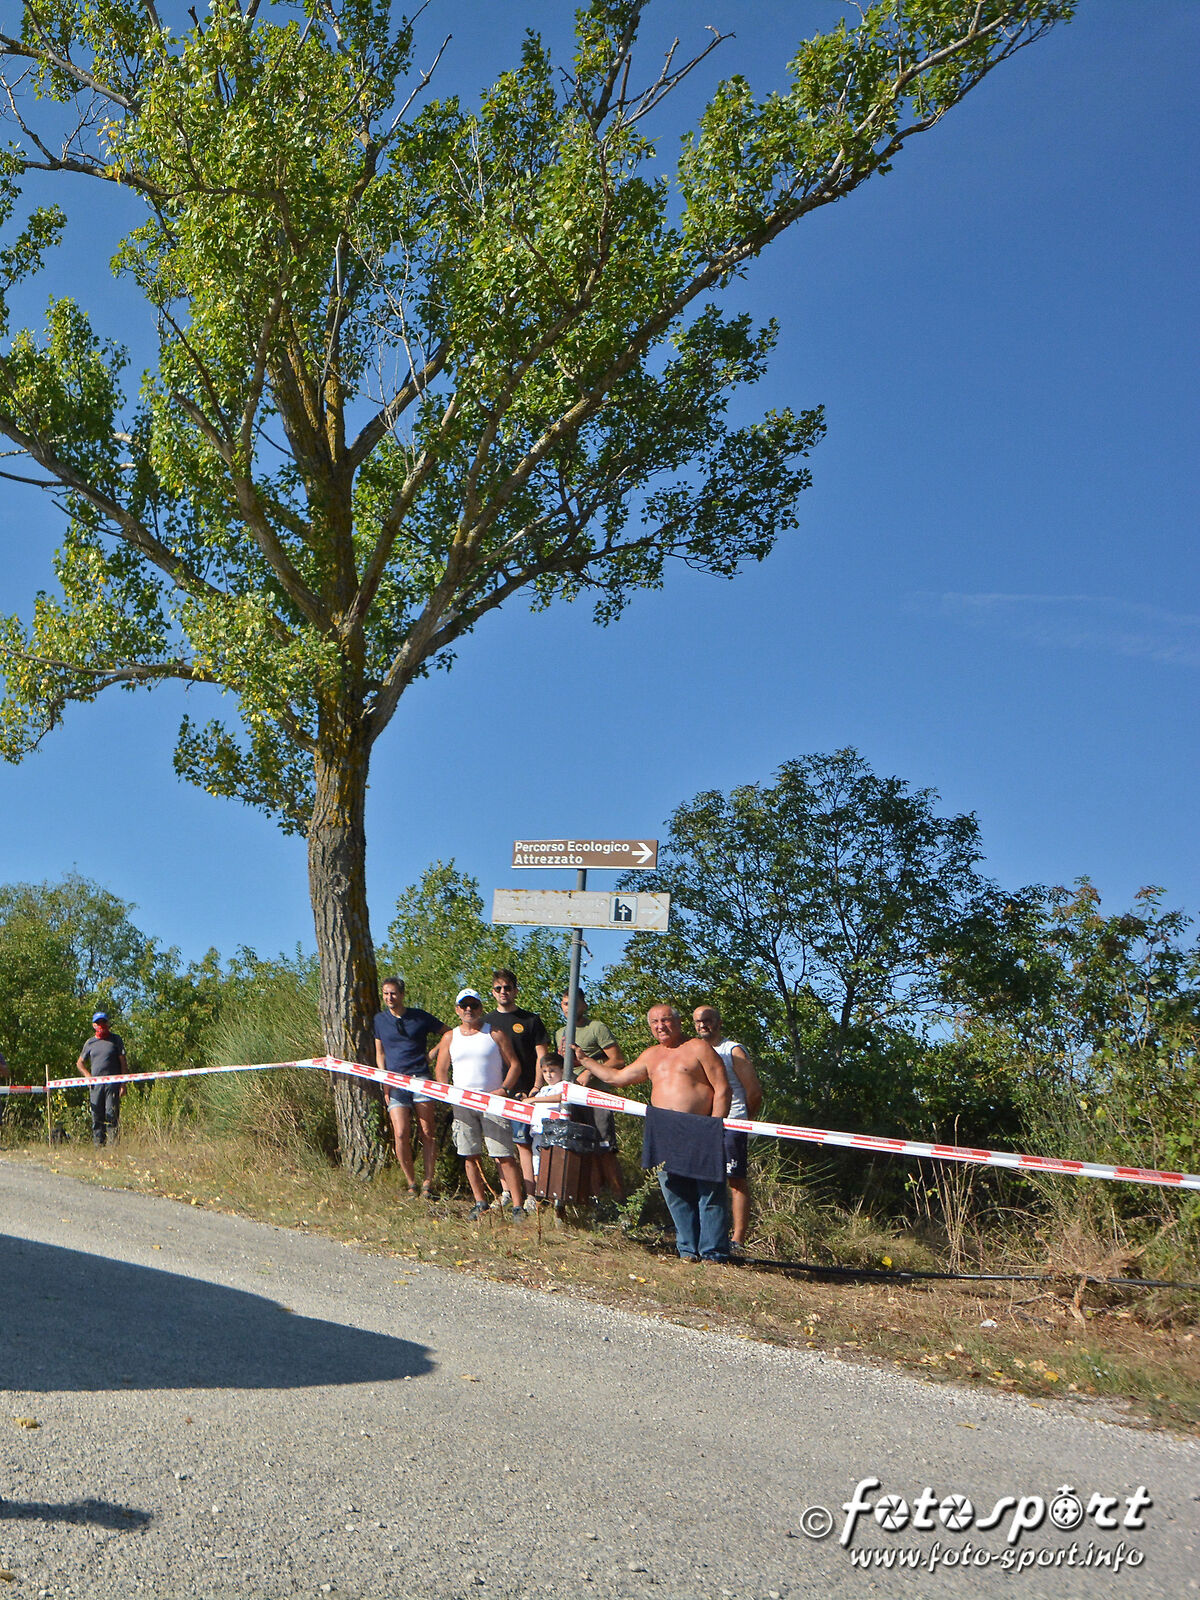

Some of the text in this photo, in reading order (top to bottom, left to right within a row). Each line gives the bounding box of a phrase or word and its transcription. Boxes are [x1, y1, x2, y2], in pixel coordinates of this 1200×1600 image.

[514, 841, 630, 854] Percorso Ecologico
[514, 853, 583, 865] Attrezzato
